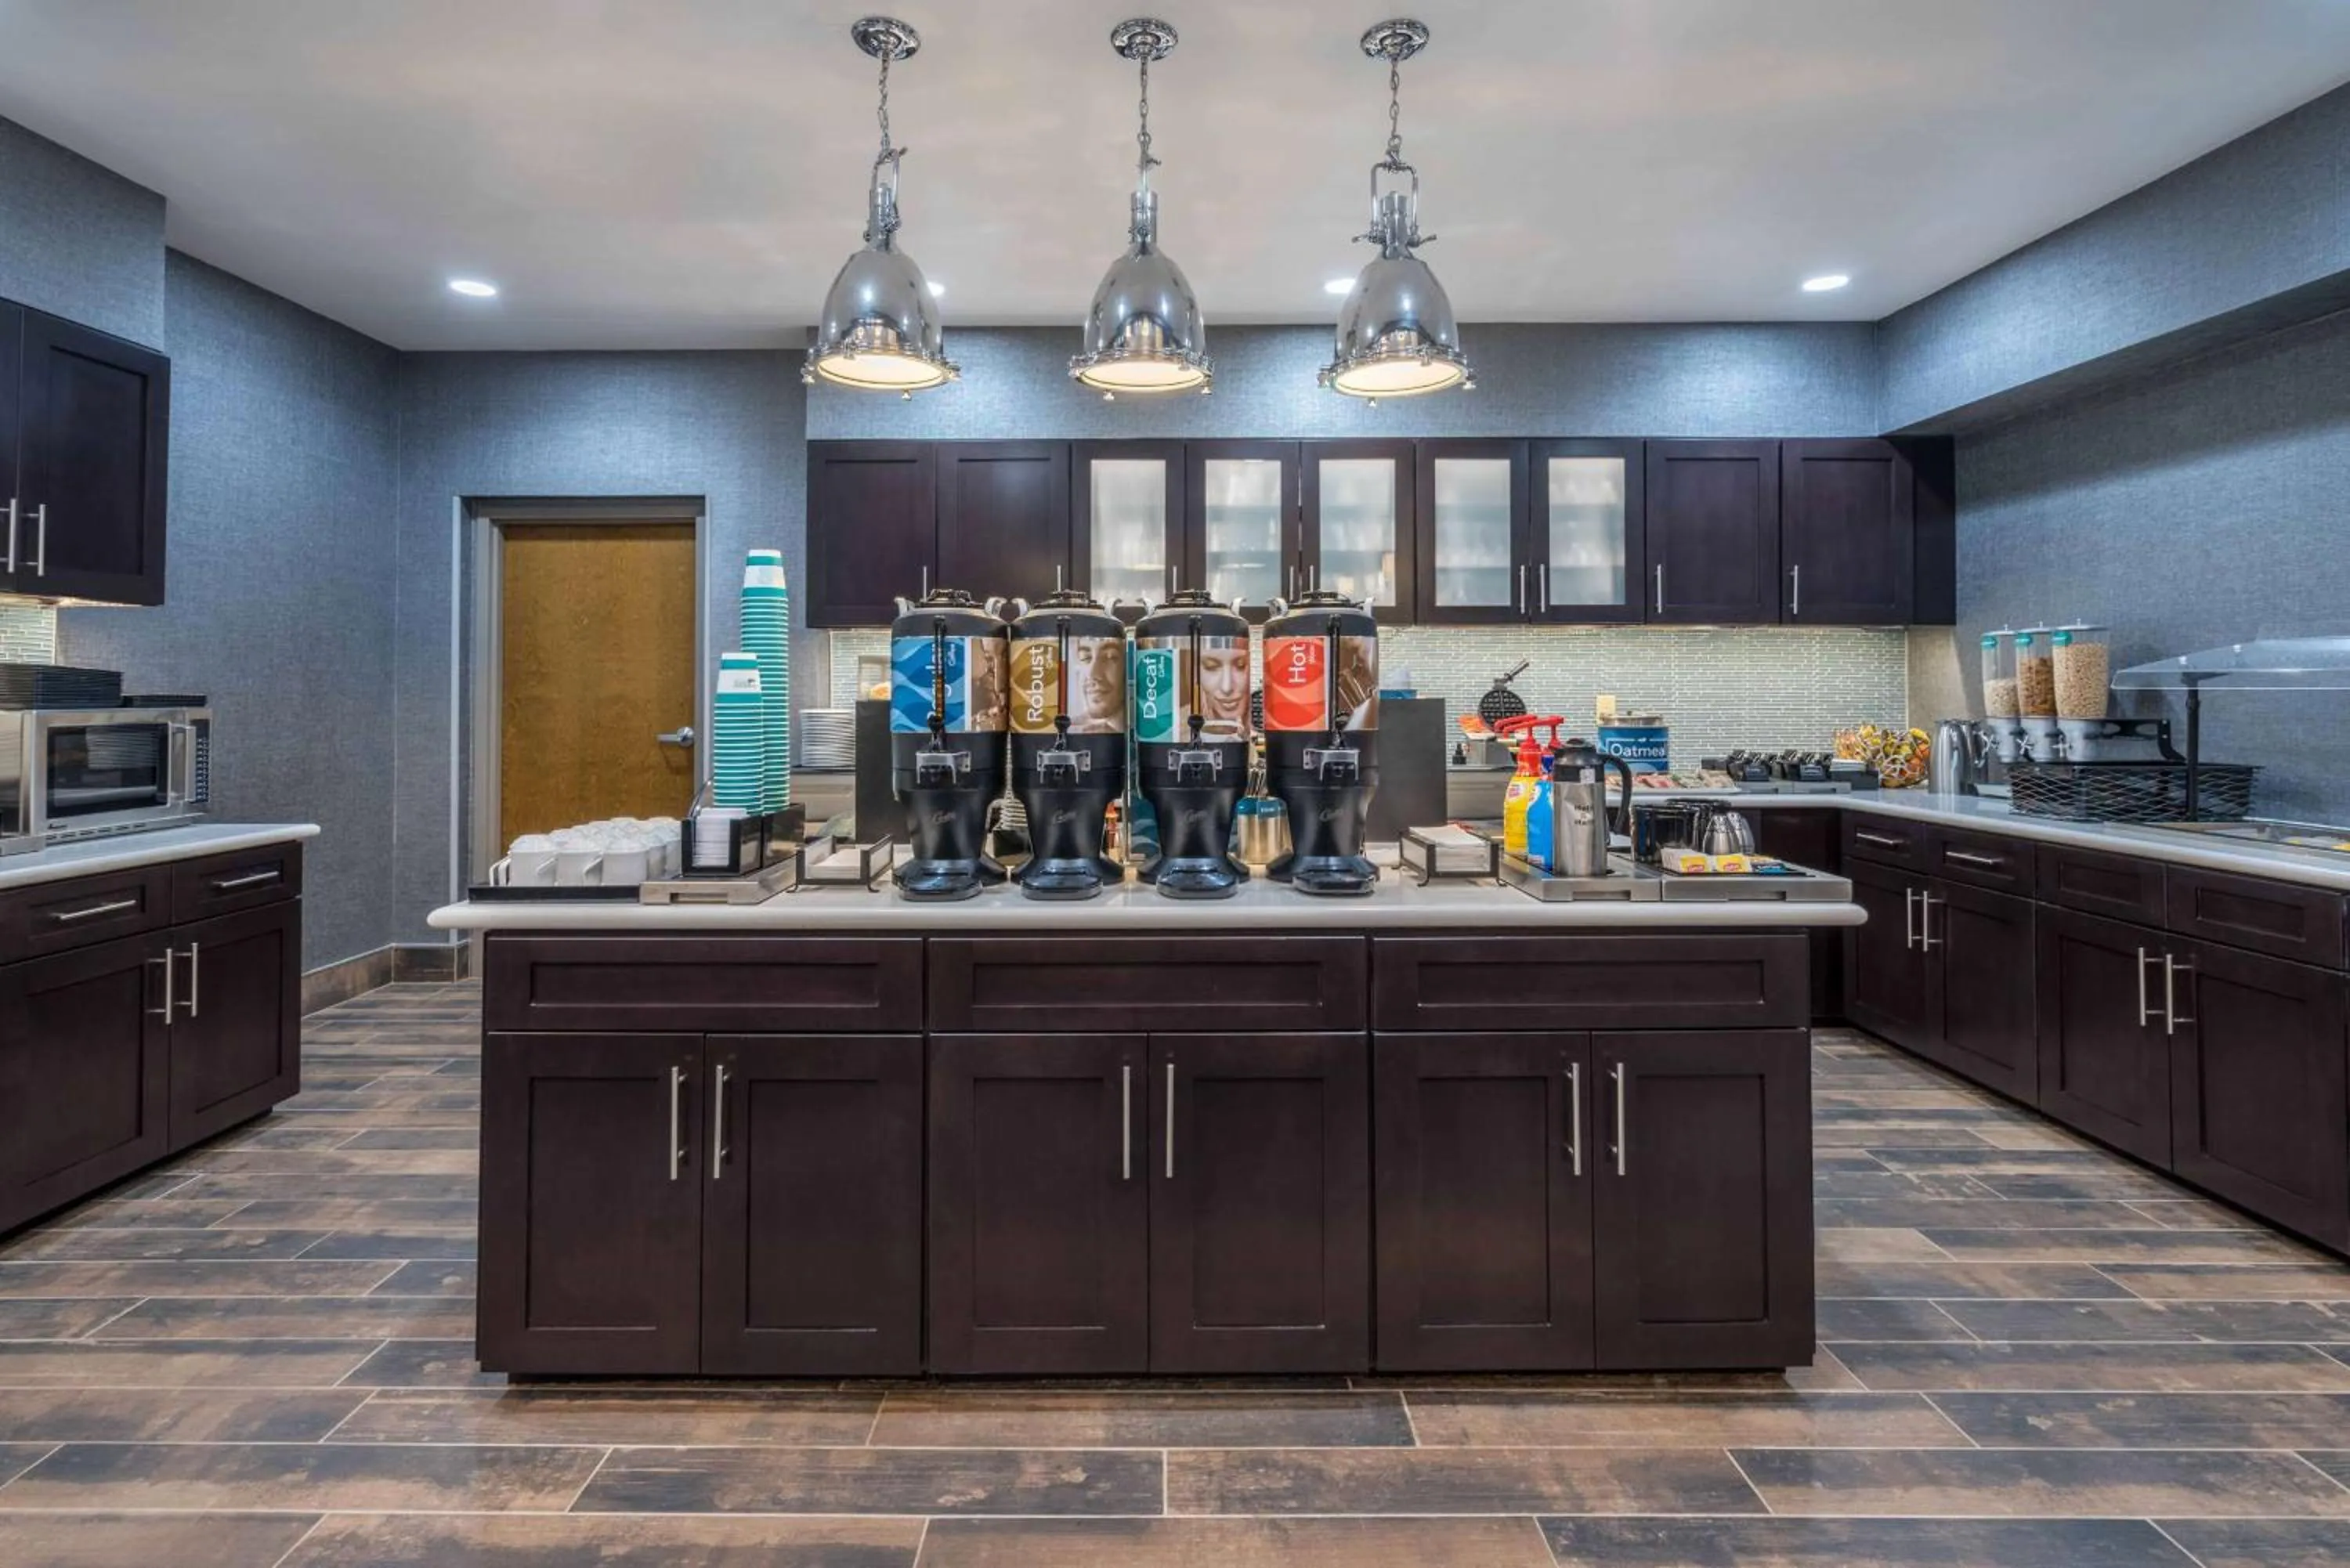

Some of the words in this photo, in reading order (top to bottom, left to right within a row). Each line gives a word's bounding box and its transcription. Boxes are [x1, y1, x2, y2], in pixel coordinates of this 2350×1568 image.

[1026, 645, 1044, 722] Robust
[1143, 656, 1157, 719] Decaf
[1288, 643, 1307, 684] Hot
[1610, 742, 1667, 757] Oatmea
